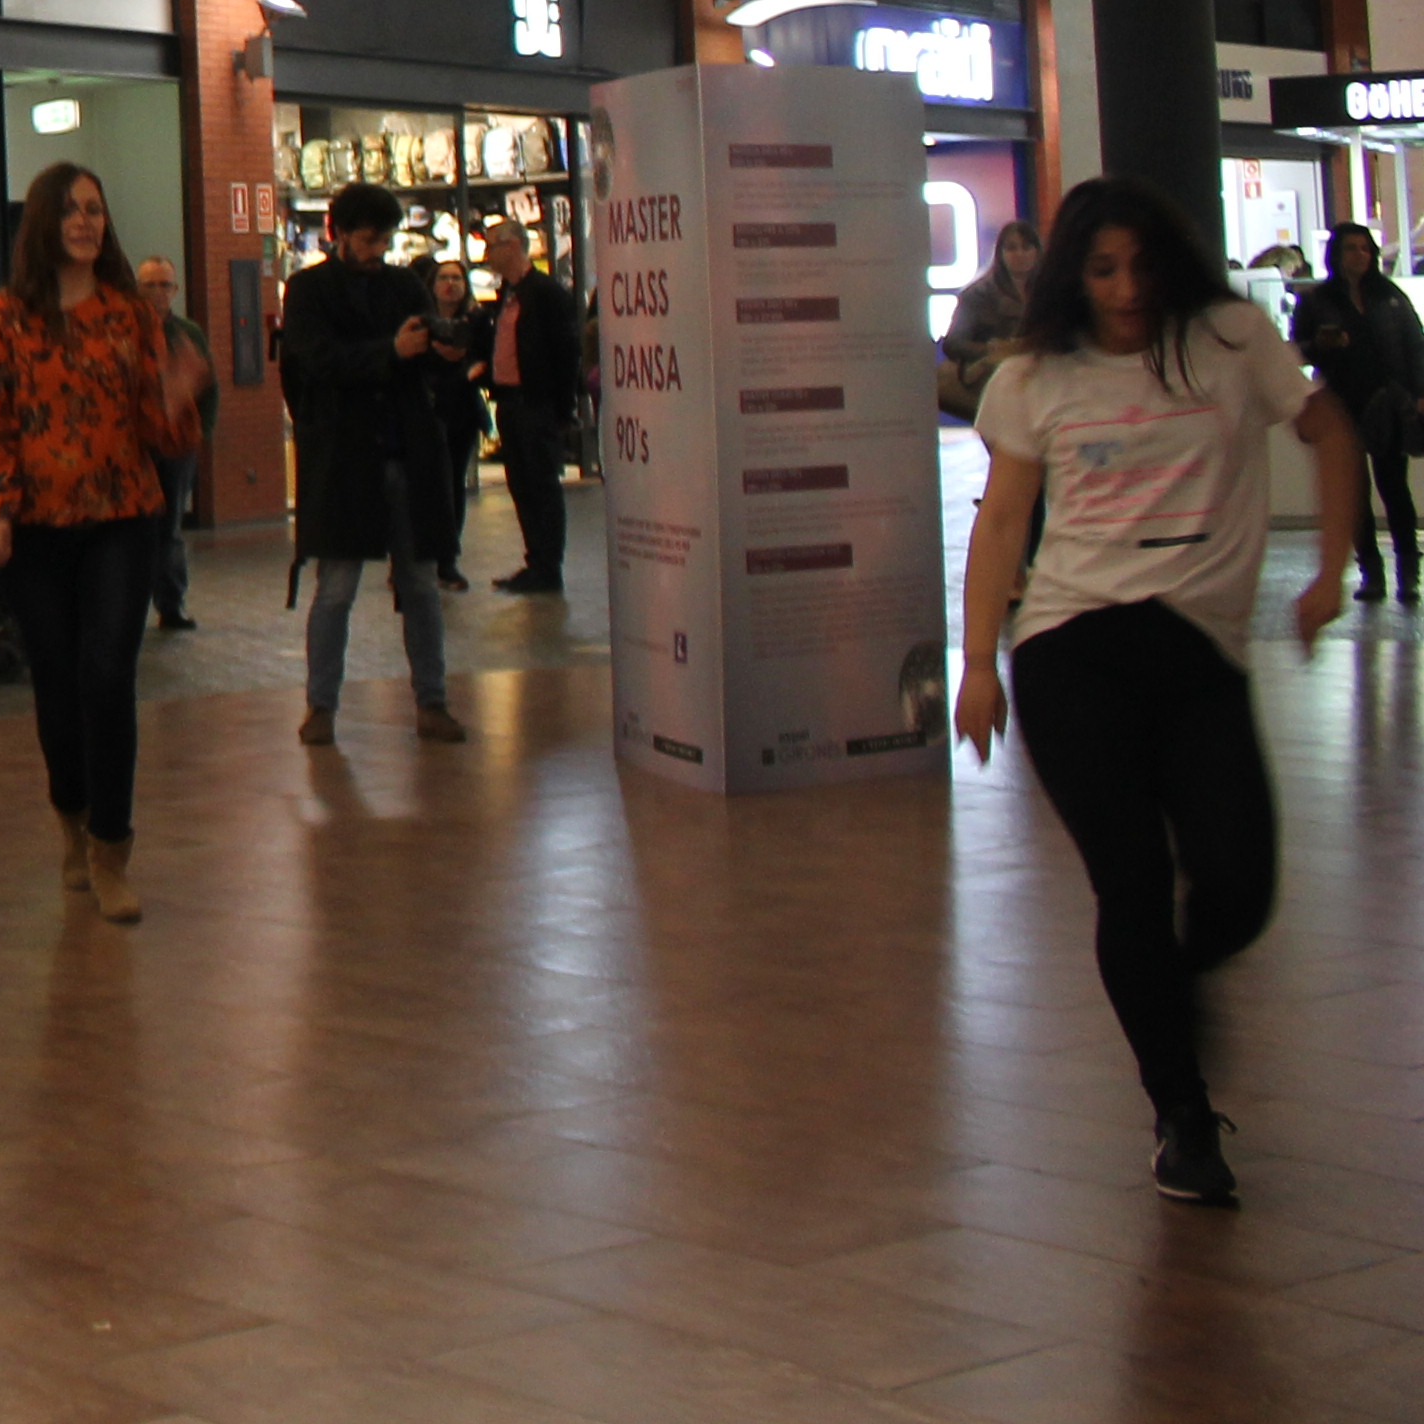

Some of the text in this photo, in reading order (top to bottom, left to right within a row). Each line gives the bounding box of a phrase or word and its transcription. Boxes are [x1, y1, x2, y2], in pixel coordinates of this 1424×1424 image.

[608, 194, 683, 245] MASTER
[611, 269, 670, 318] CLASS
[613, 343, 683, 392] DANSA
[616, 415, 650, 464] 90's
